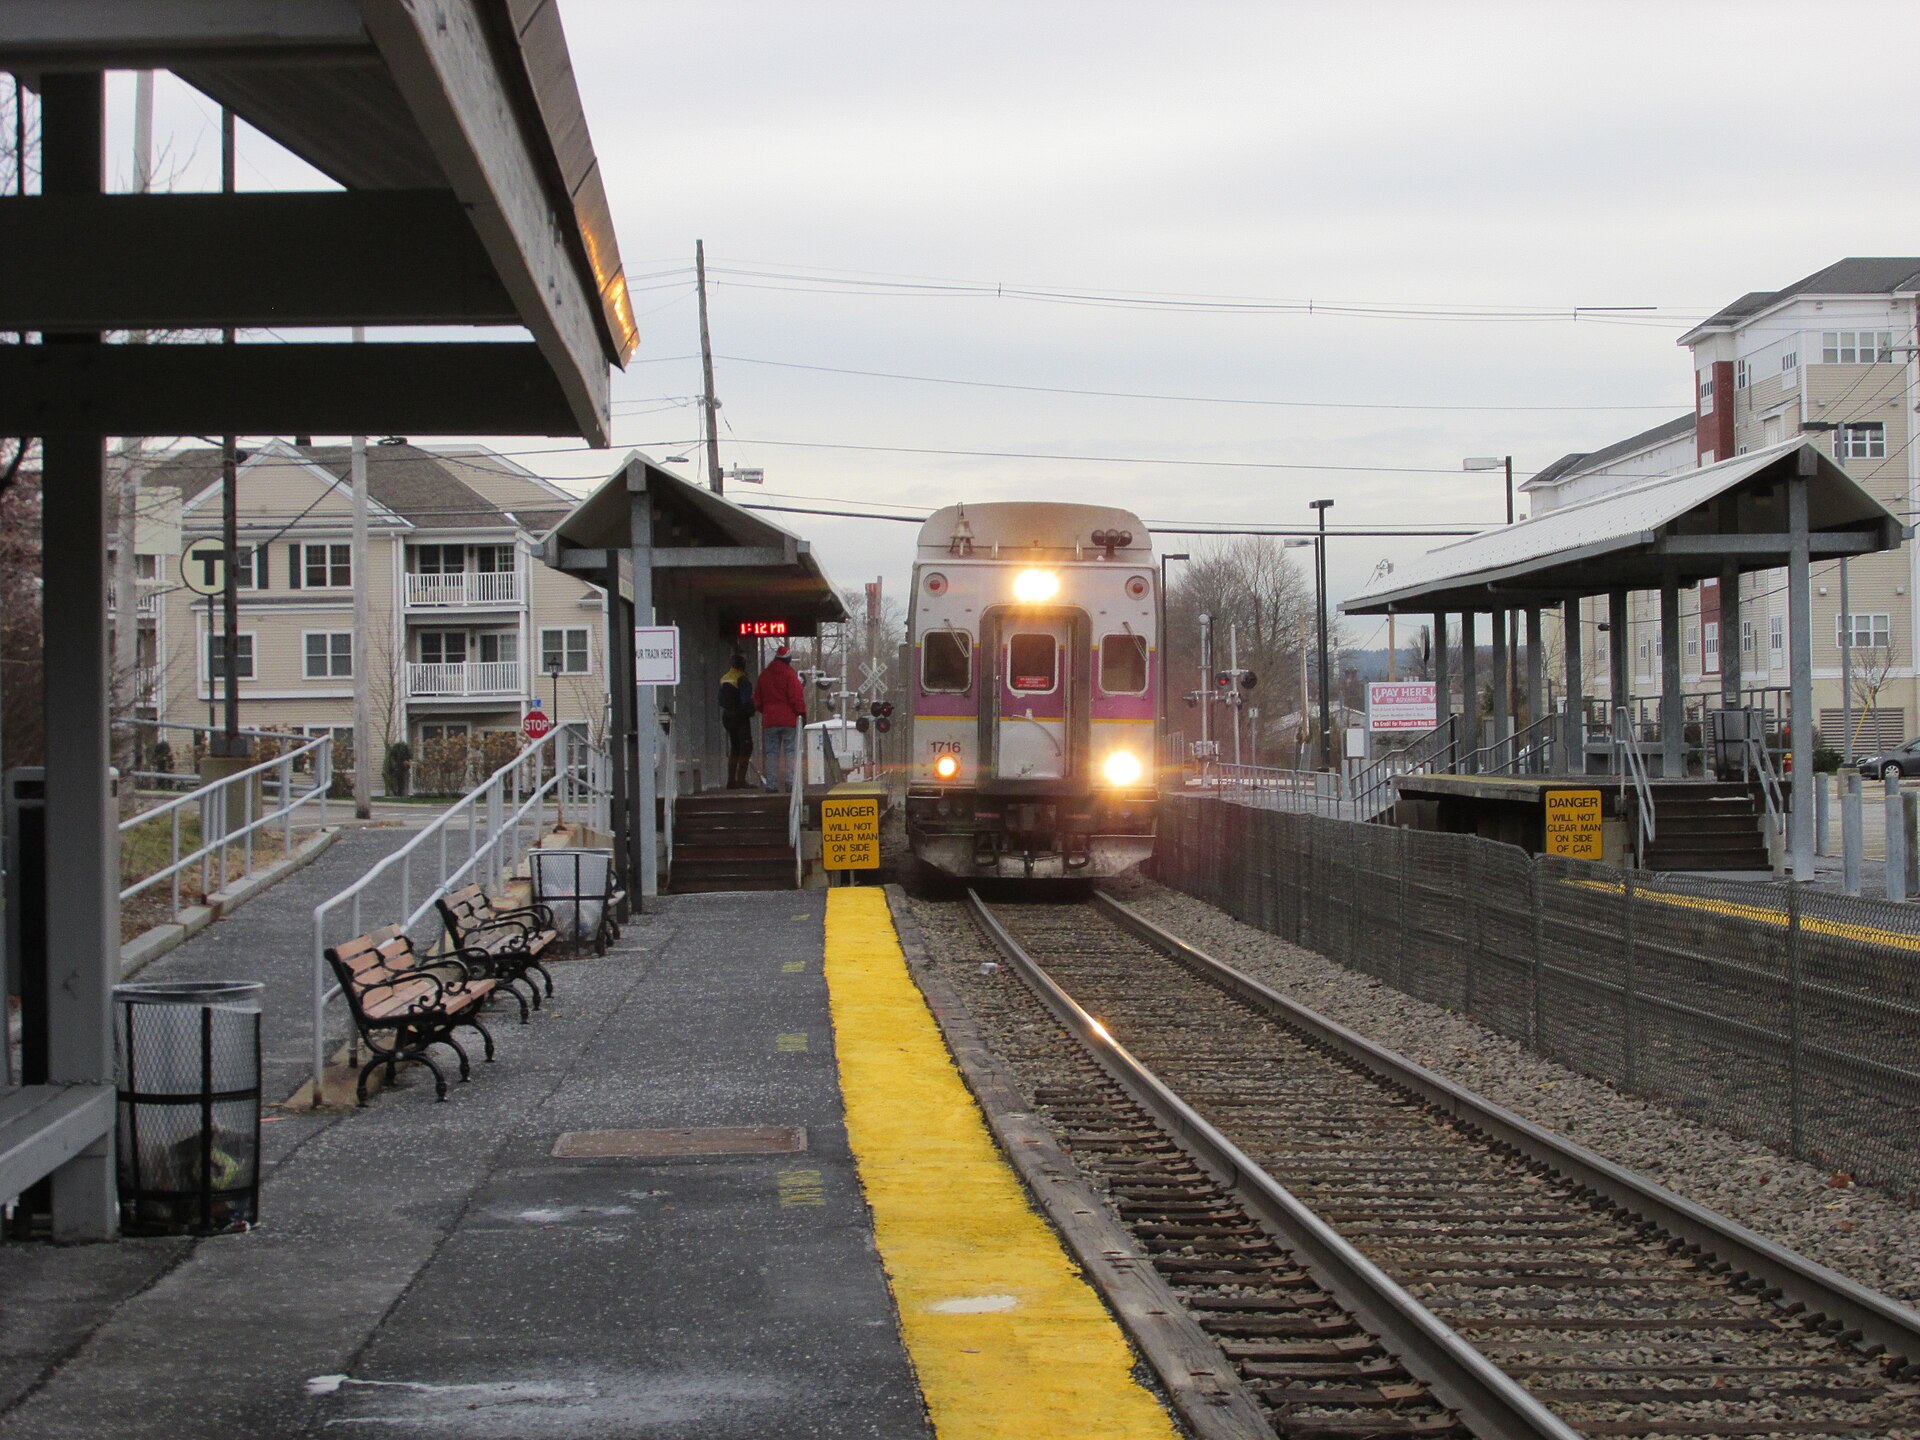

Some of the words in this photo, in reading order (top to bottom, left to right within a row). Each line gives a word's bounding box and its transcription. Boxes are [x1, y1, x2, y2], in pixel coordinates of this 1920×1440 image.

[192, 550, 225, 586] T
[740, 622, 768, 635] 1:12
[770, 622, 785, 634] PM
[645, 648, 660, 659] TRAIN
[661, 648, 673, 659] HERE
[1381, 688, 1399, 697] PAY
[1402, 687, 1428, 697] HERE
[524, 719, 548, 731] STOP
[931, 741, 961, 753] 1716
[1549, 797, 1598, 808] DANGER
[825, 806, 875, 818] DANGER
[1577, 813, 1595, 821] NOT
[828, 823, 850, 831] WILL
[854, 822, 872, 830] NOT
[1547, 824, 1577, 832] CLEAR
[1581, 824, 1601, 832] MAN
[824, 833, 854, 842] CLEAR
[858, 832, 878, 840] MAN
[1573, 834, 1592, 842] SIDE
[832, 844, 846, 852] ON
[850, 843, 870, 852] SIDE
[1557, 845, 1569, 853] OF
[1573, 845, 1592, 853] CAR
[834, 854, 846, 863] OF
[850, 853, 869, 863] CAR
